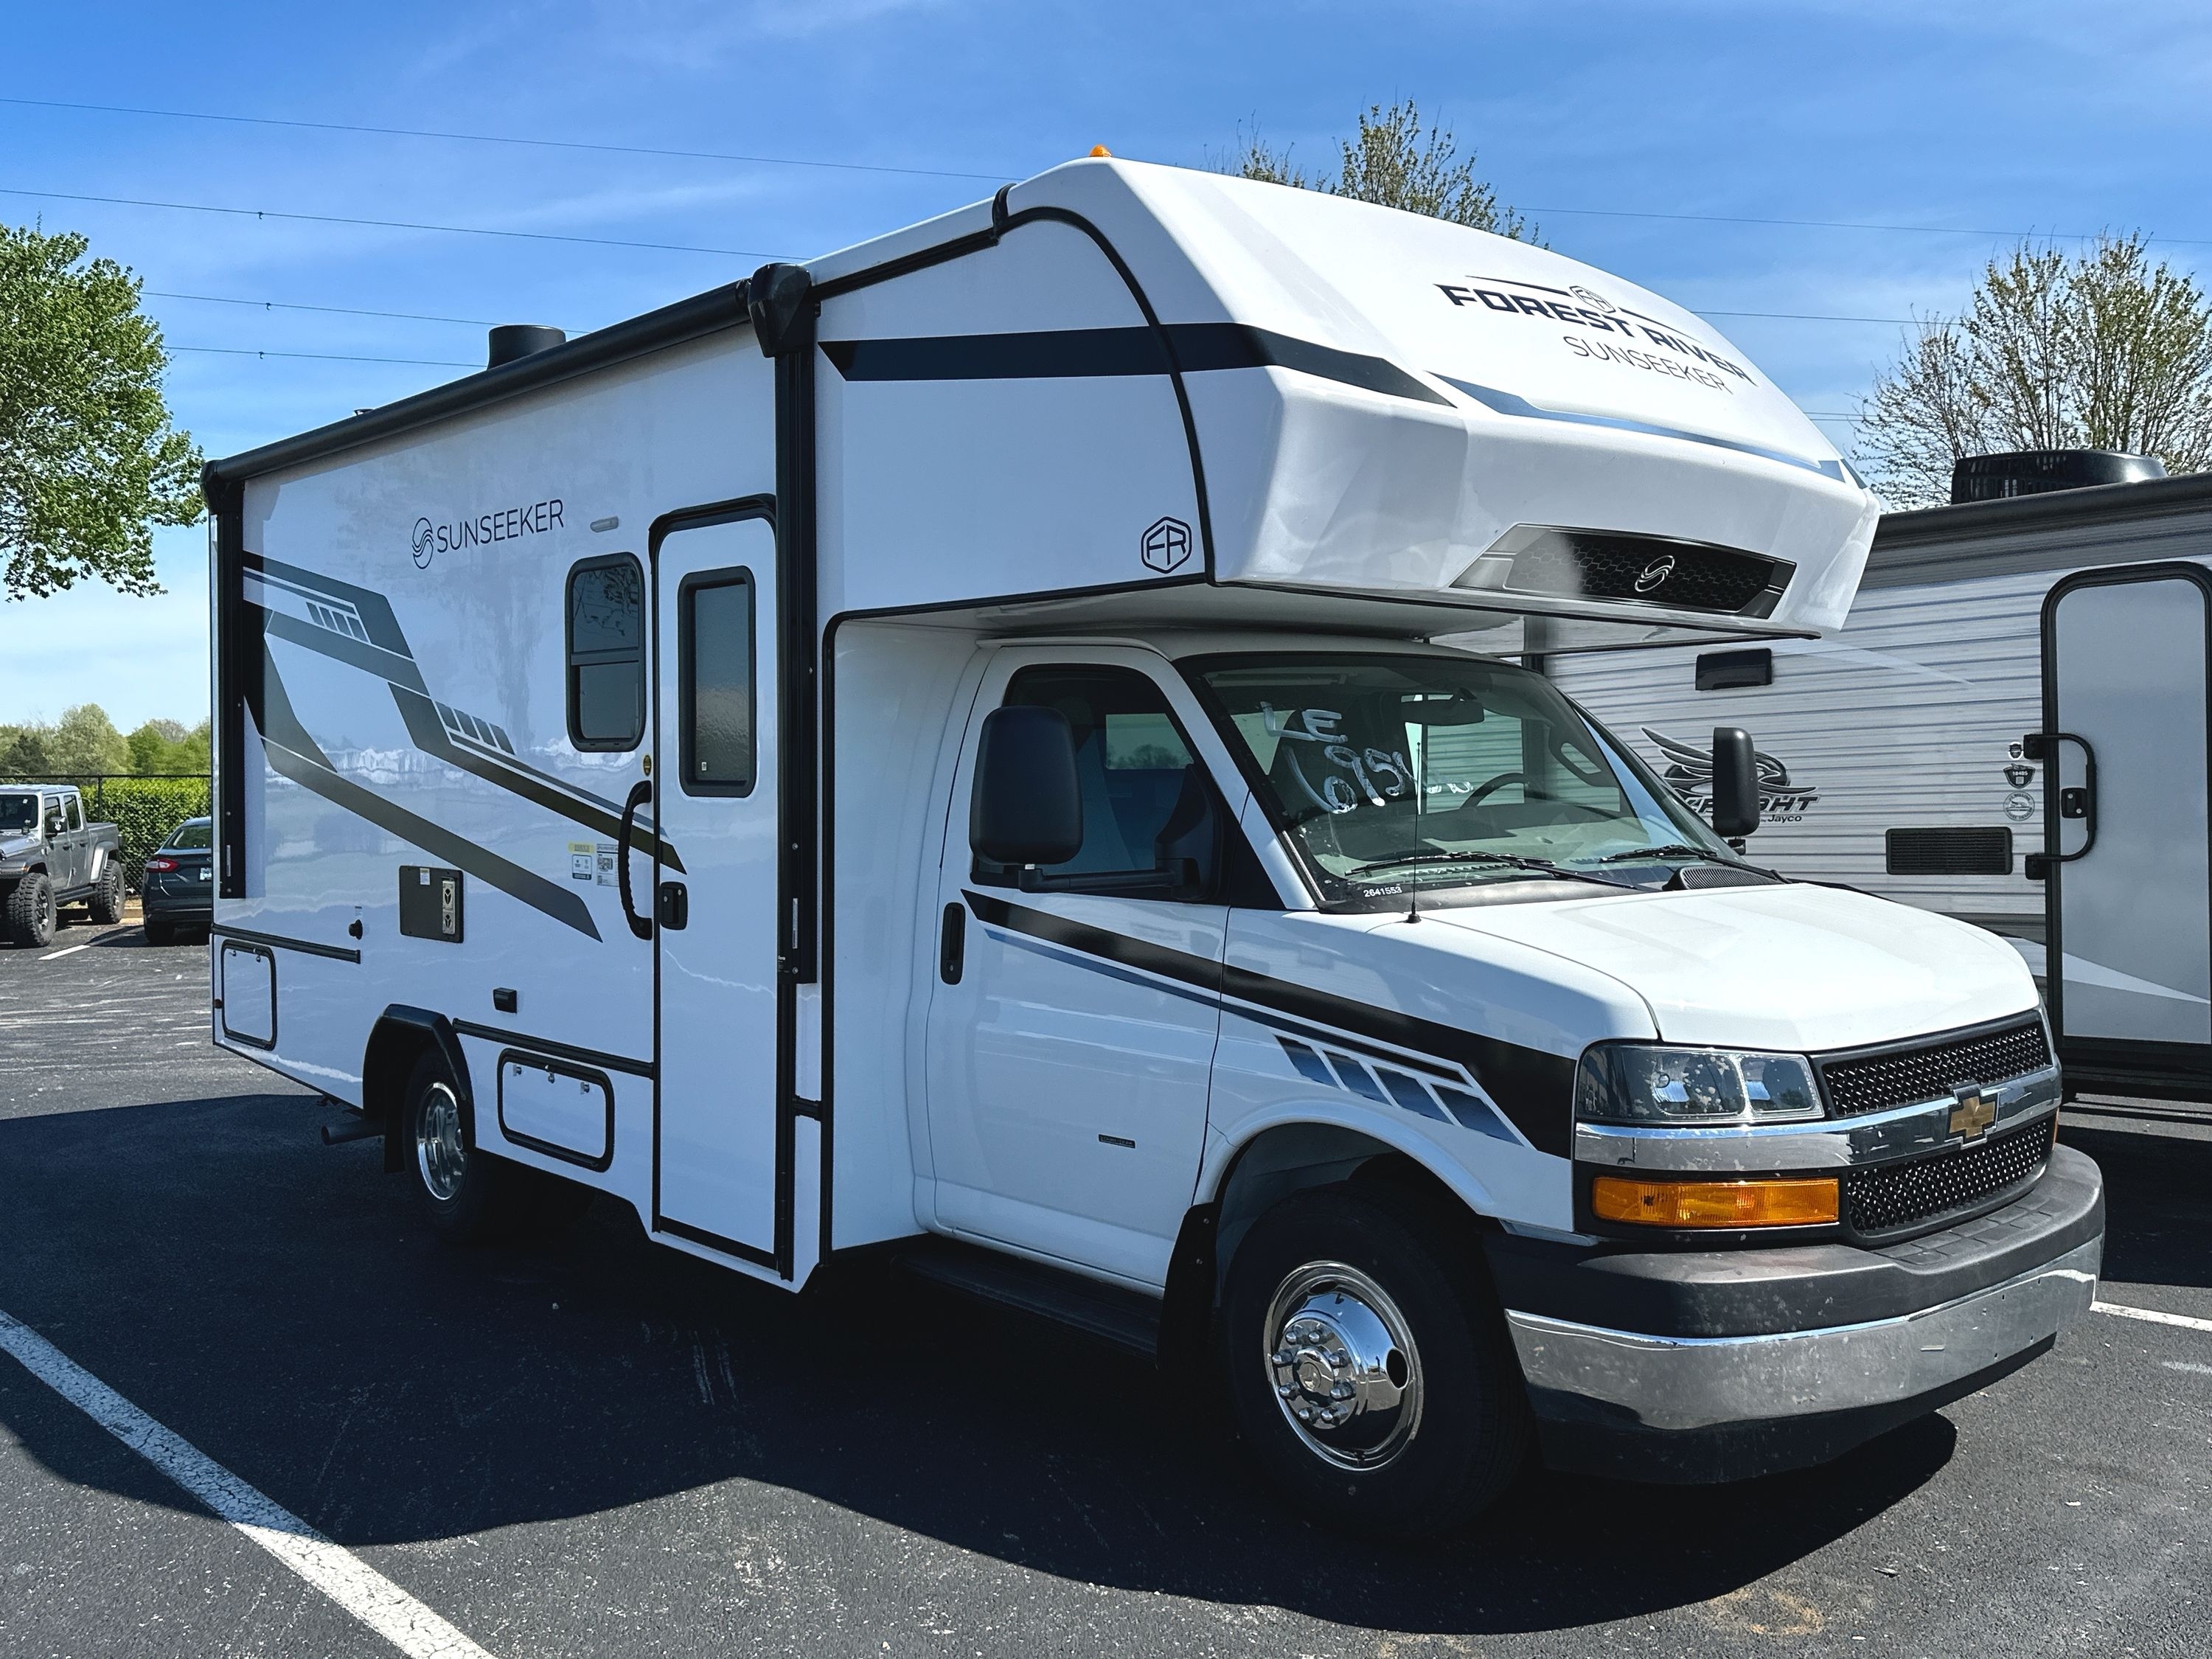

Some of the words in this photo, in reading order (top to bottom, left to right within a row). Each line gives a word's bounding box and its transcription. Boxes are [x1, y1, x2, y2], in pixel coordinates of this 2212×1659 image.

[1433, 283, 1635, 336] FOREST
[1637, 324, 1759, 387] RIVER
[1562, 335, 1733, 394] SUNSEEKER
[437, 498, 564, 553] SUNSEEKER
[1767, 814, 1802, 823] Jayco
